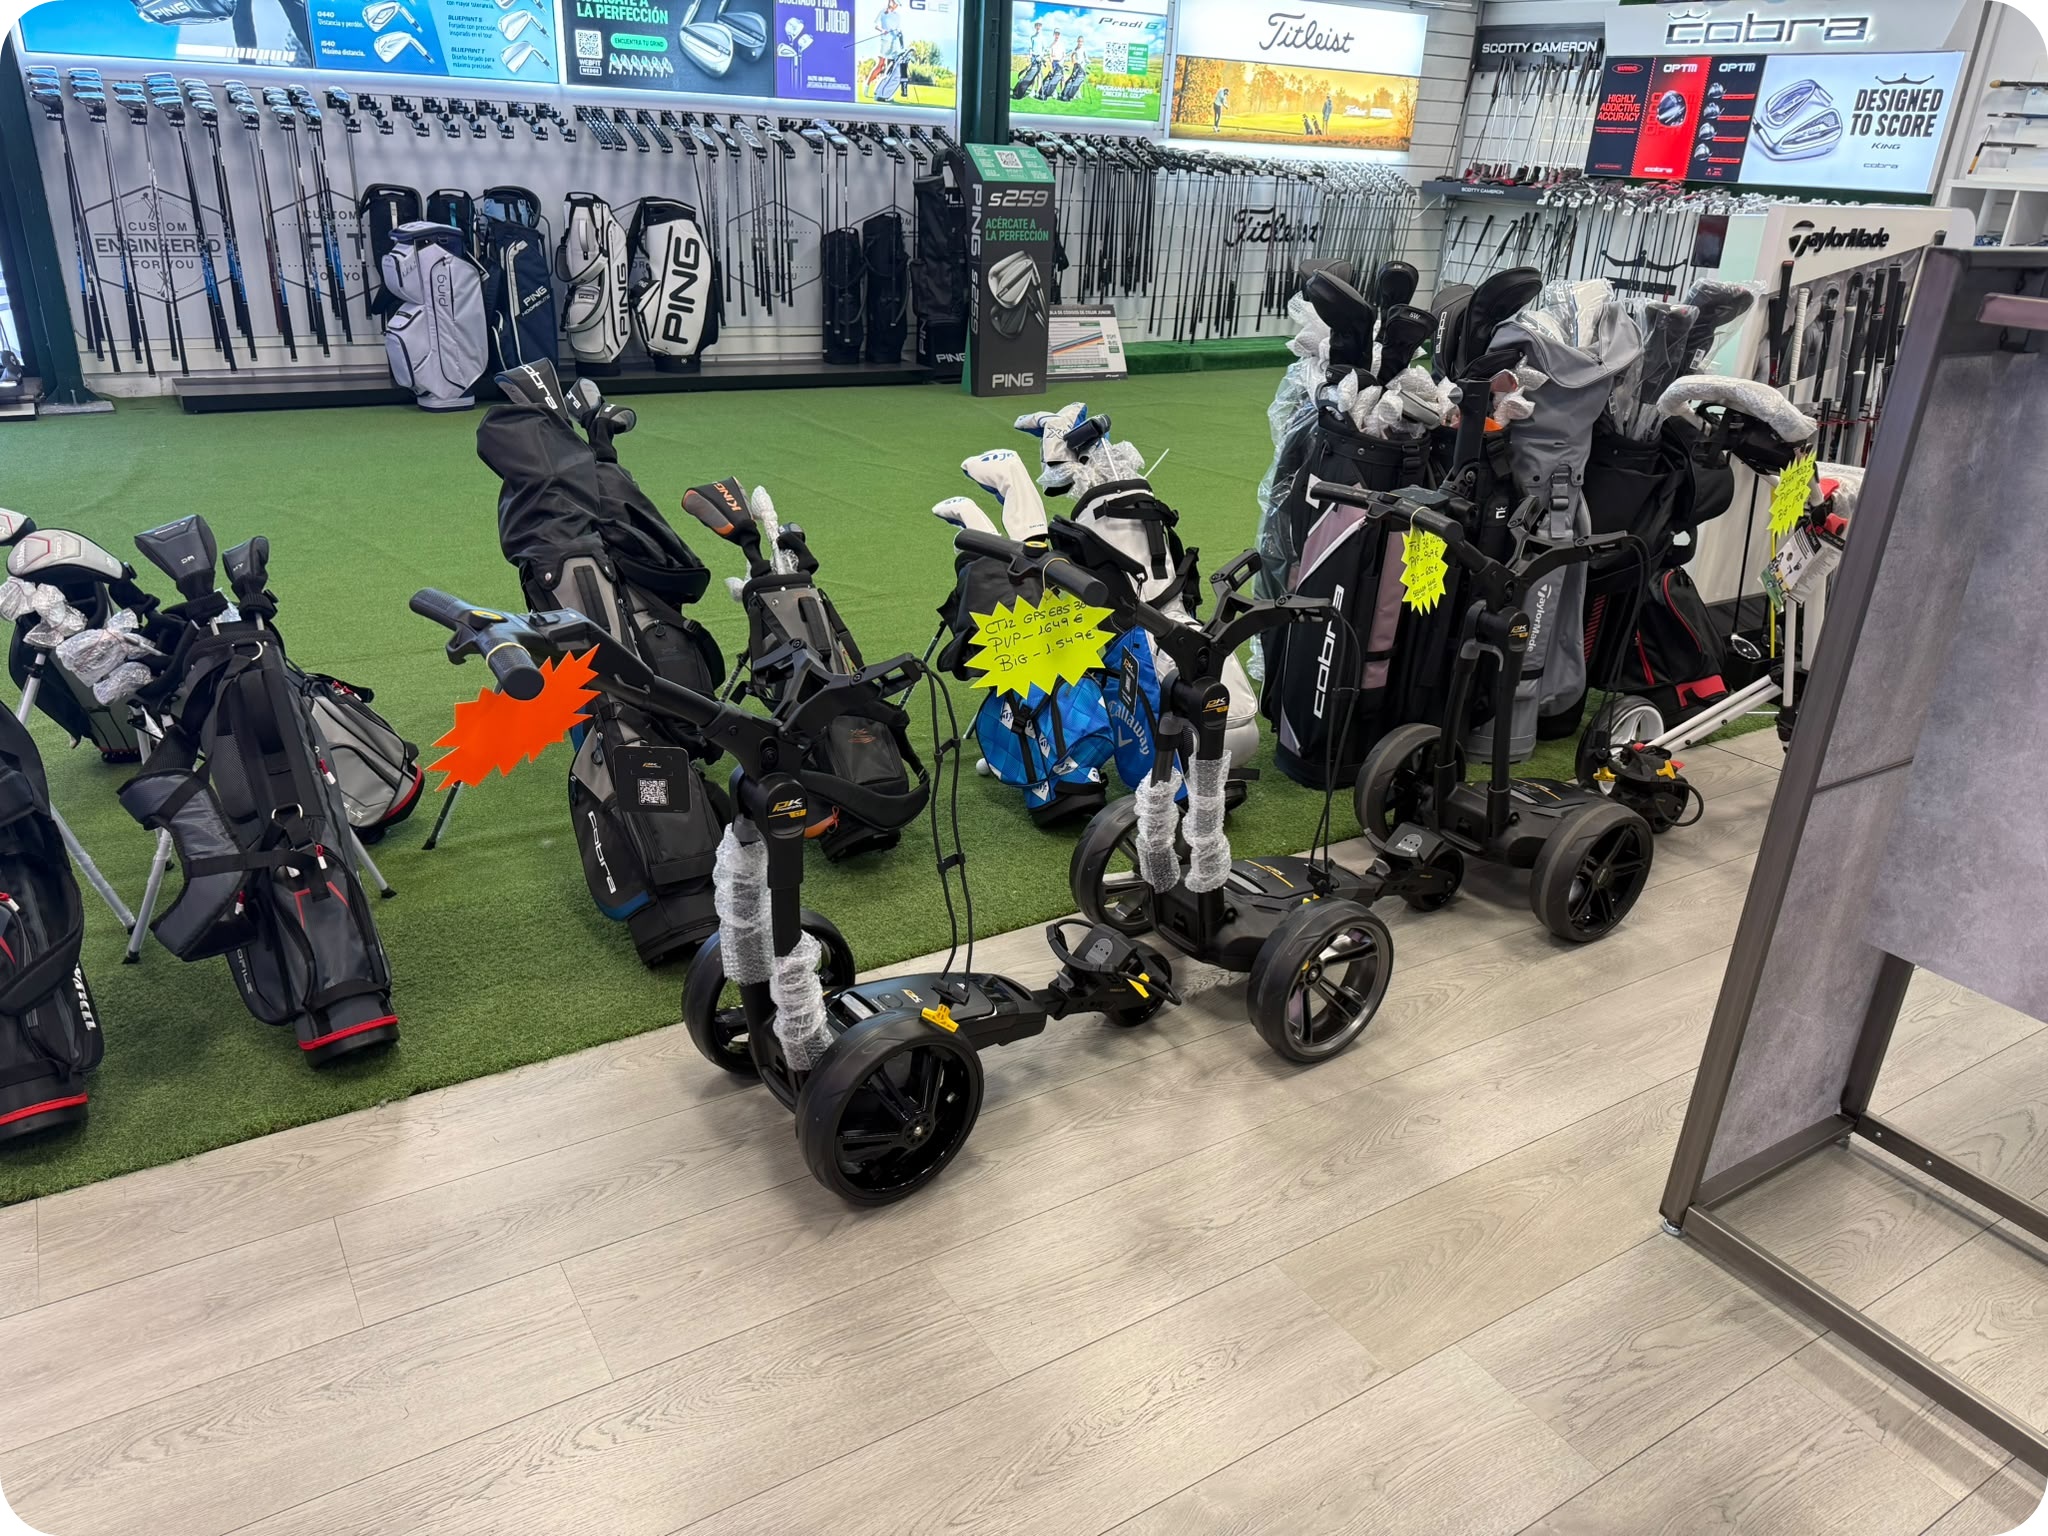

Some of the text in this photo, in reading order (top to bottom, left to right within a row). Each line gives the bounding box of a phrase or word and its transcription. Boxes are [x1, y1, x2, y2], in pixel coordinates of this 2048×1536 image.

[150, 2, 192, 20] PING
[577, 2, 669, 25] LA PERFECCIÓN
[815, 8, 850, 34] TU JUEGO
[1258, 12, 1355, 54] Titleist
[1664, 12, 1869, 45] cobra
[614, 37, 642, 46] ENCUENTRA
[1481, 41, 1598, 54] SCOTTY CAMERON
[1600, 103, 1641, 112] ADDICTIVE
[1607, 94, 1637, 103] HIGHLY
[1853, 88, 1944, 113] DESIGNED
[1597, 111, 1641, 121] ACCURACY
[1850, 113, 1937, 138] TO SCORE
[1870, 142, 1901, 150] KING
[128, 221, 188, 232] CUSTOM
[971, 183, 982, 257] PING
[985, 215, 1036, 229] ACÉRCATE A
[985, 229, 1049, 242] LA PERFECCIÓN
[1788, 220, 1890, 258] TaylorMade
[522, 285, 548, 307] PING
[616, 262, 629, 337] PING
[661, 236, 700, 345] PING
[1435, 311, 1448, 354] cobra
[991, 372, 1034, 389] PING
[984, 618, 1017, 635] CT12
[1023, 610, 1046, 625] GPS
[1048, 603, 1071, 617] EBS
[1526, 582, 1552, 653] TaylorMade
[587, 810, 617, 895] cobra
[72, 961, 97, 1031] Wilso
